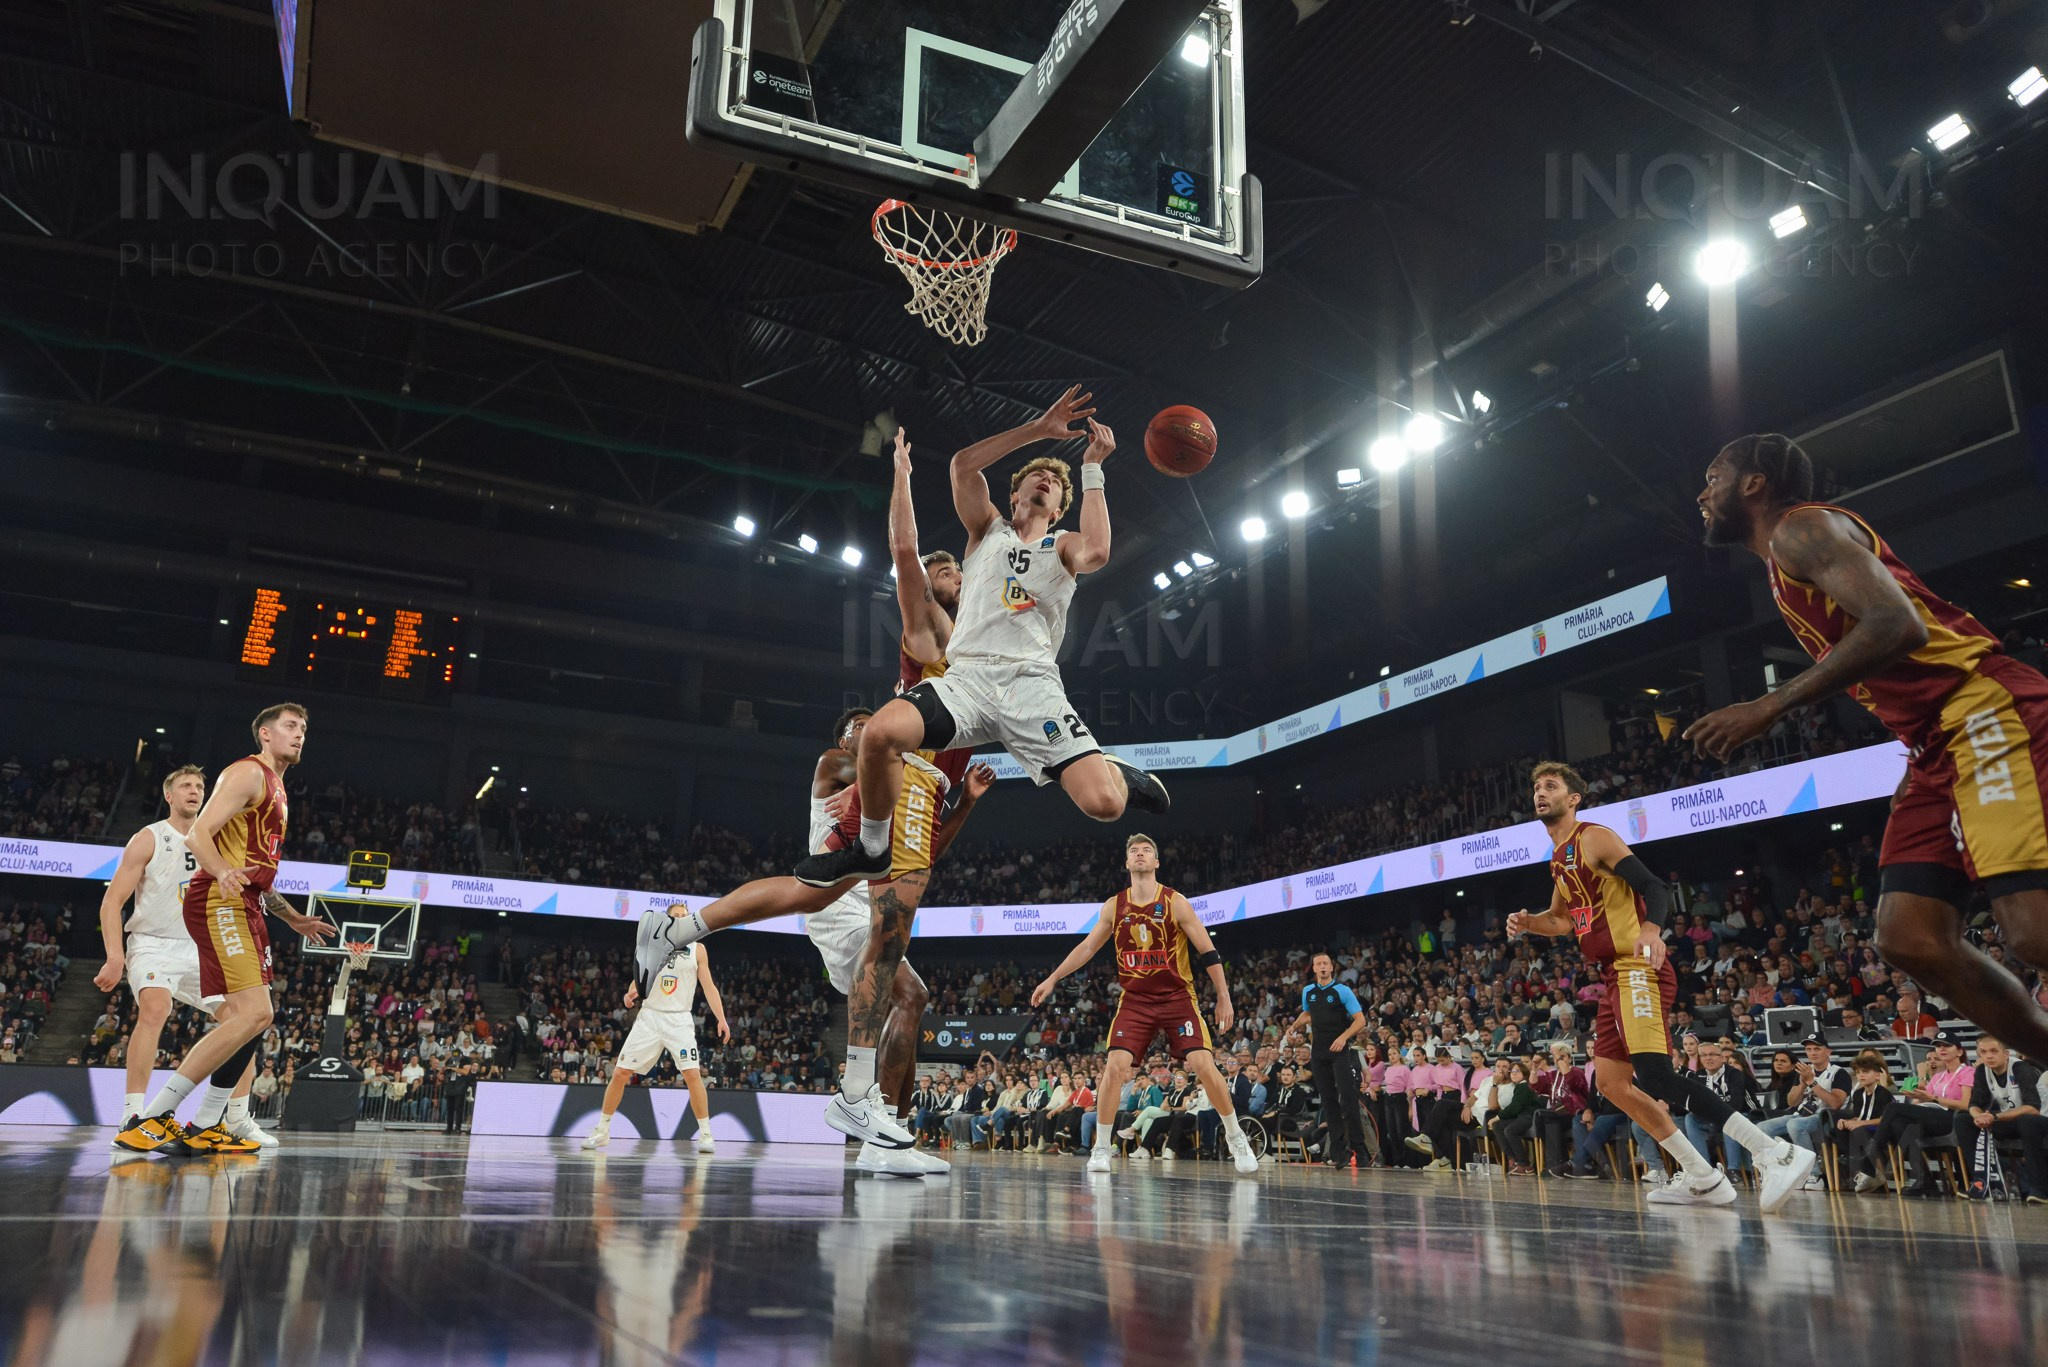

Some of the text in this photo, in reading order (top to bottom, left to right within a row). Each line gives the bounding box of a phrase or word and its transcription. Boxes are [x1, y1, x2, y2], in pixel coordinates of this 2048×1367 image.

[1038, 4, 1098, 96] sports
[769, 80, 813, 97] oneteam
[1165, 206, 1201, 224] EuroCup
[1563, 604, 1604, 631] PRIMĂRIA
[1577, 610, 1635, 641] CLUJ-NAPOCA
[1403, 668, 1435, 689] PRIMĂRIA
[1413, 674, 1458, 698] CLUJ-NAPOCA
[1134, 745, 1171, 758] PRIMĂRIA
[1965, 707, 2017, 806] REYER
[1145, 756, 1197, 768] CLUJ-NAPOCA
[1670, 786, 1724, 812] PRIMĂRIA
[904, 784, 928, 852] REYER
[1690, 798, 1768, 828] CLUJ-NAPOCA
[1461, 835, 1501, 856] PRIMĂRIA
[0, 856, 73, 874] CLUJ-NAPOCA
[1474, 846, 1531, 870] CLUJ-NAPOCA
[451, 879, 494, 893] PRIMĂRIA
[1305, 871, 1336, 889] PRIMĂRIA
[463, 893, 523, 909] CLUJ-NAPOCA
[1315, 882, 1358, 902] CLUJ-NAPOCA
[1002, 908, 1041, 920] PRIMĂRIA
[1014, 920, 1068, 933] CLUJ-NAPOCA
[1125, 953, 1168, 968] UMANA
[663, 979, 674, 987] BT
[979, 1033, 995, 1041] 09
[1184, 1020, 1194, 1037] 8
[690, 1048, 698, 1061] 9
